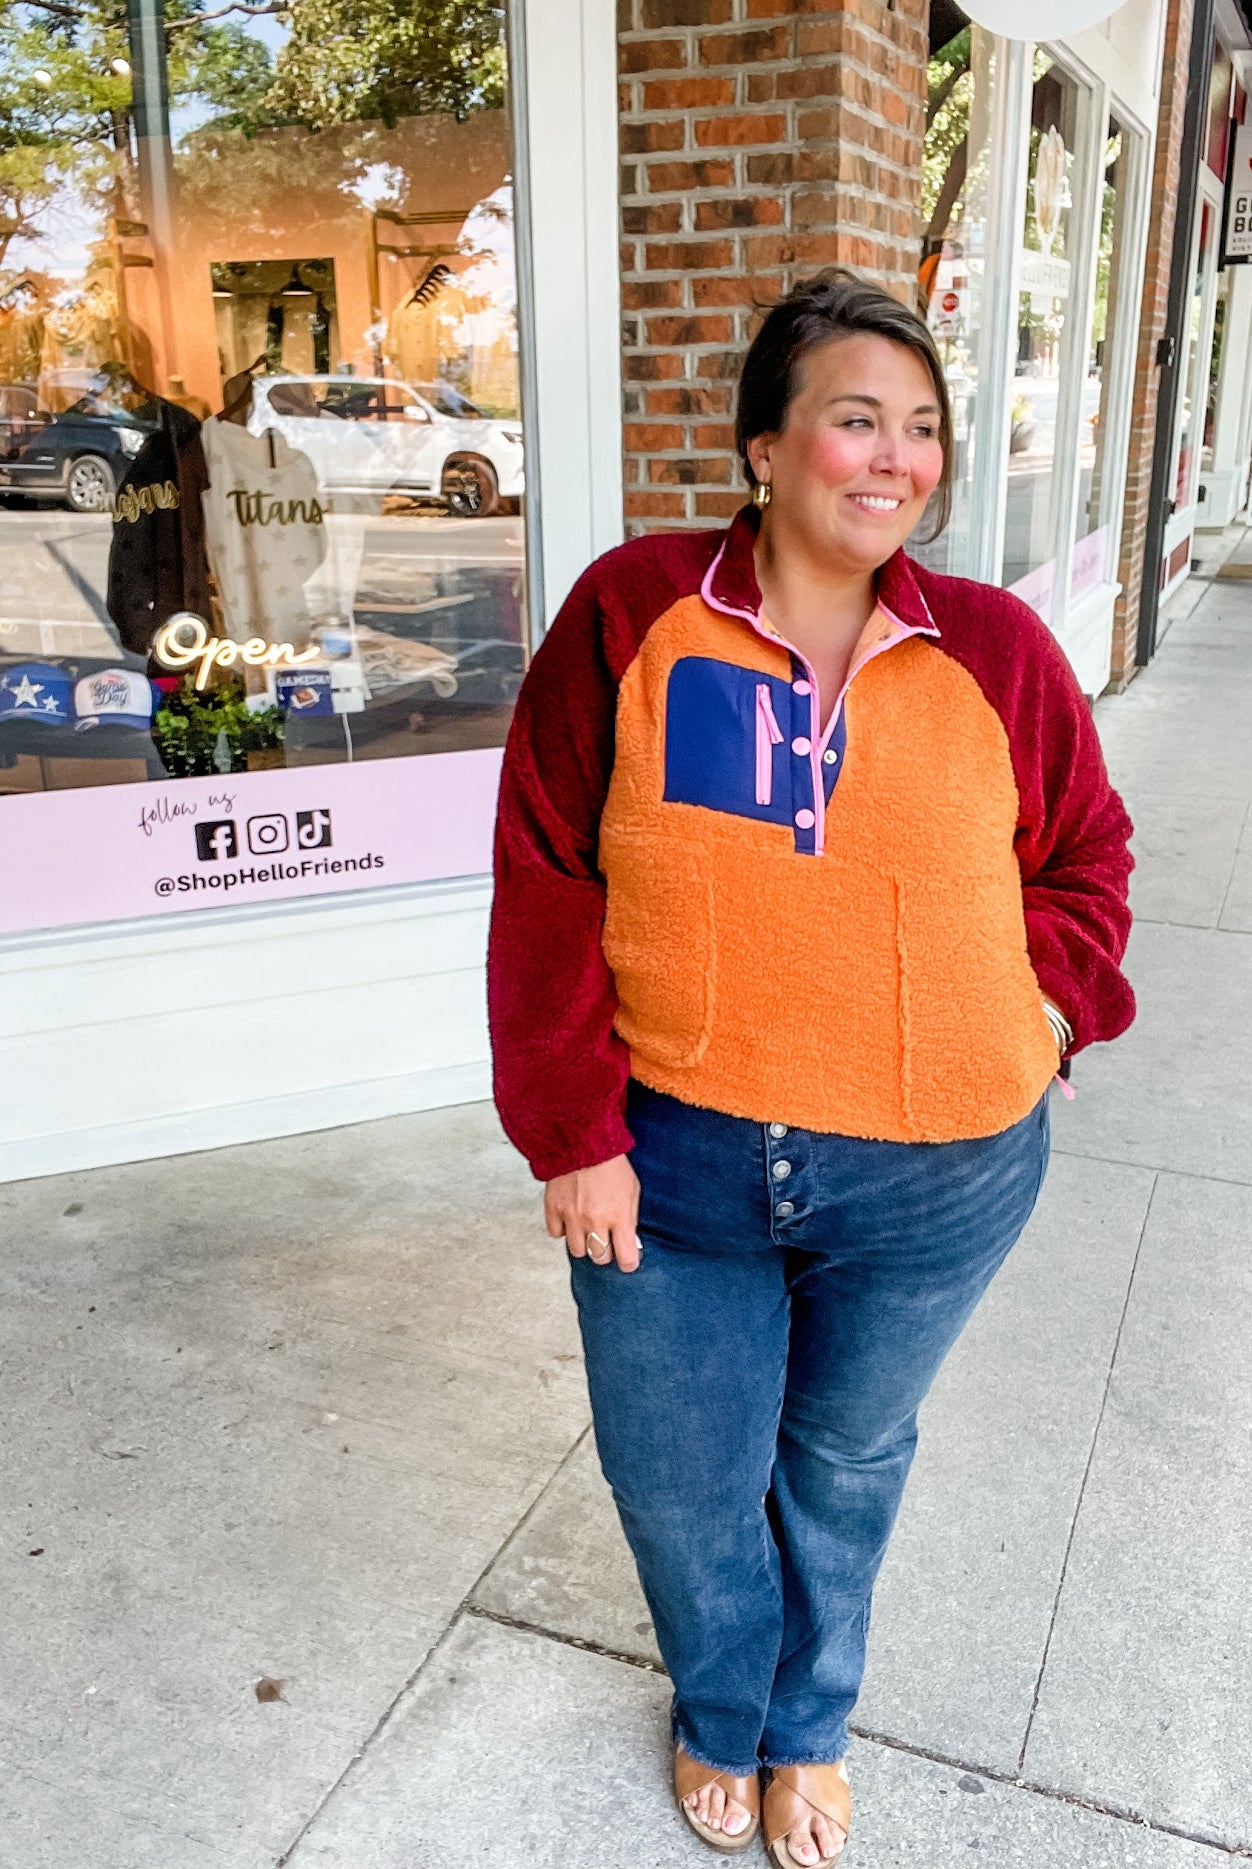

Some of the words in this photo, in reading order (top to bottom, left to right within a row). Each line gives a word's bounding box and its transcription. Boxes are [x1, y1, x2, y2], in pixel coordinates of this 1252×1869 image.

[1235, 197, 1252, 213] G
[1234, 217, 1252, 233] B
[226, 490, 328, 526] Titans
[156, 616, 321, 691] Open
[138, 797, 197, 836] follow
[208, 793, 237, 812] us
[155, 853, 385, 897] @ShopHelloFriends
